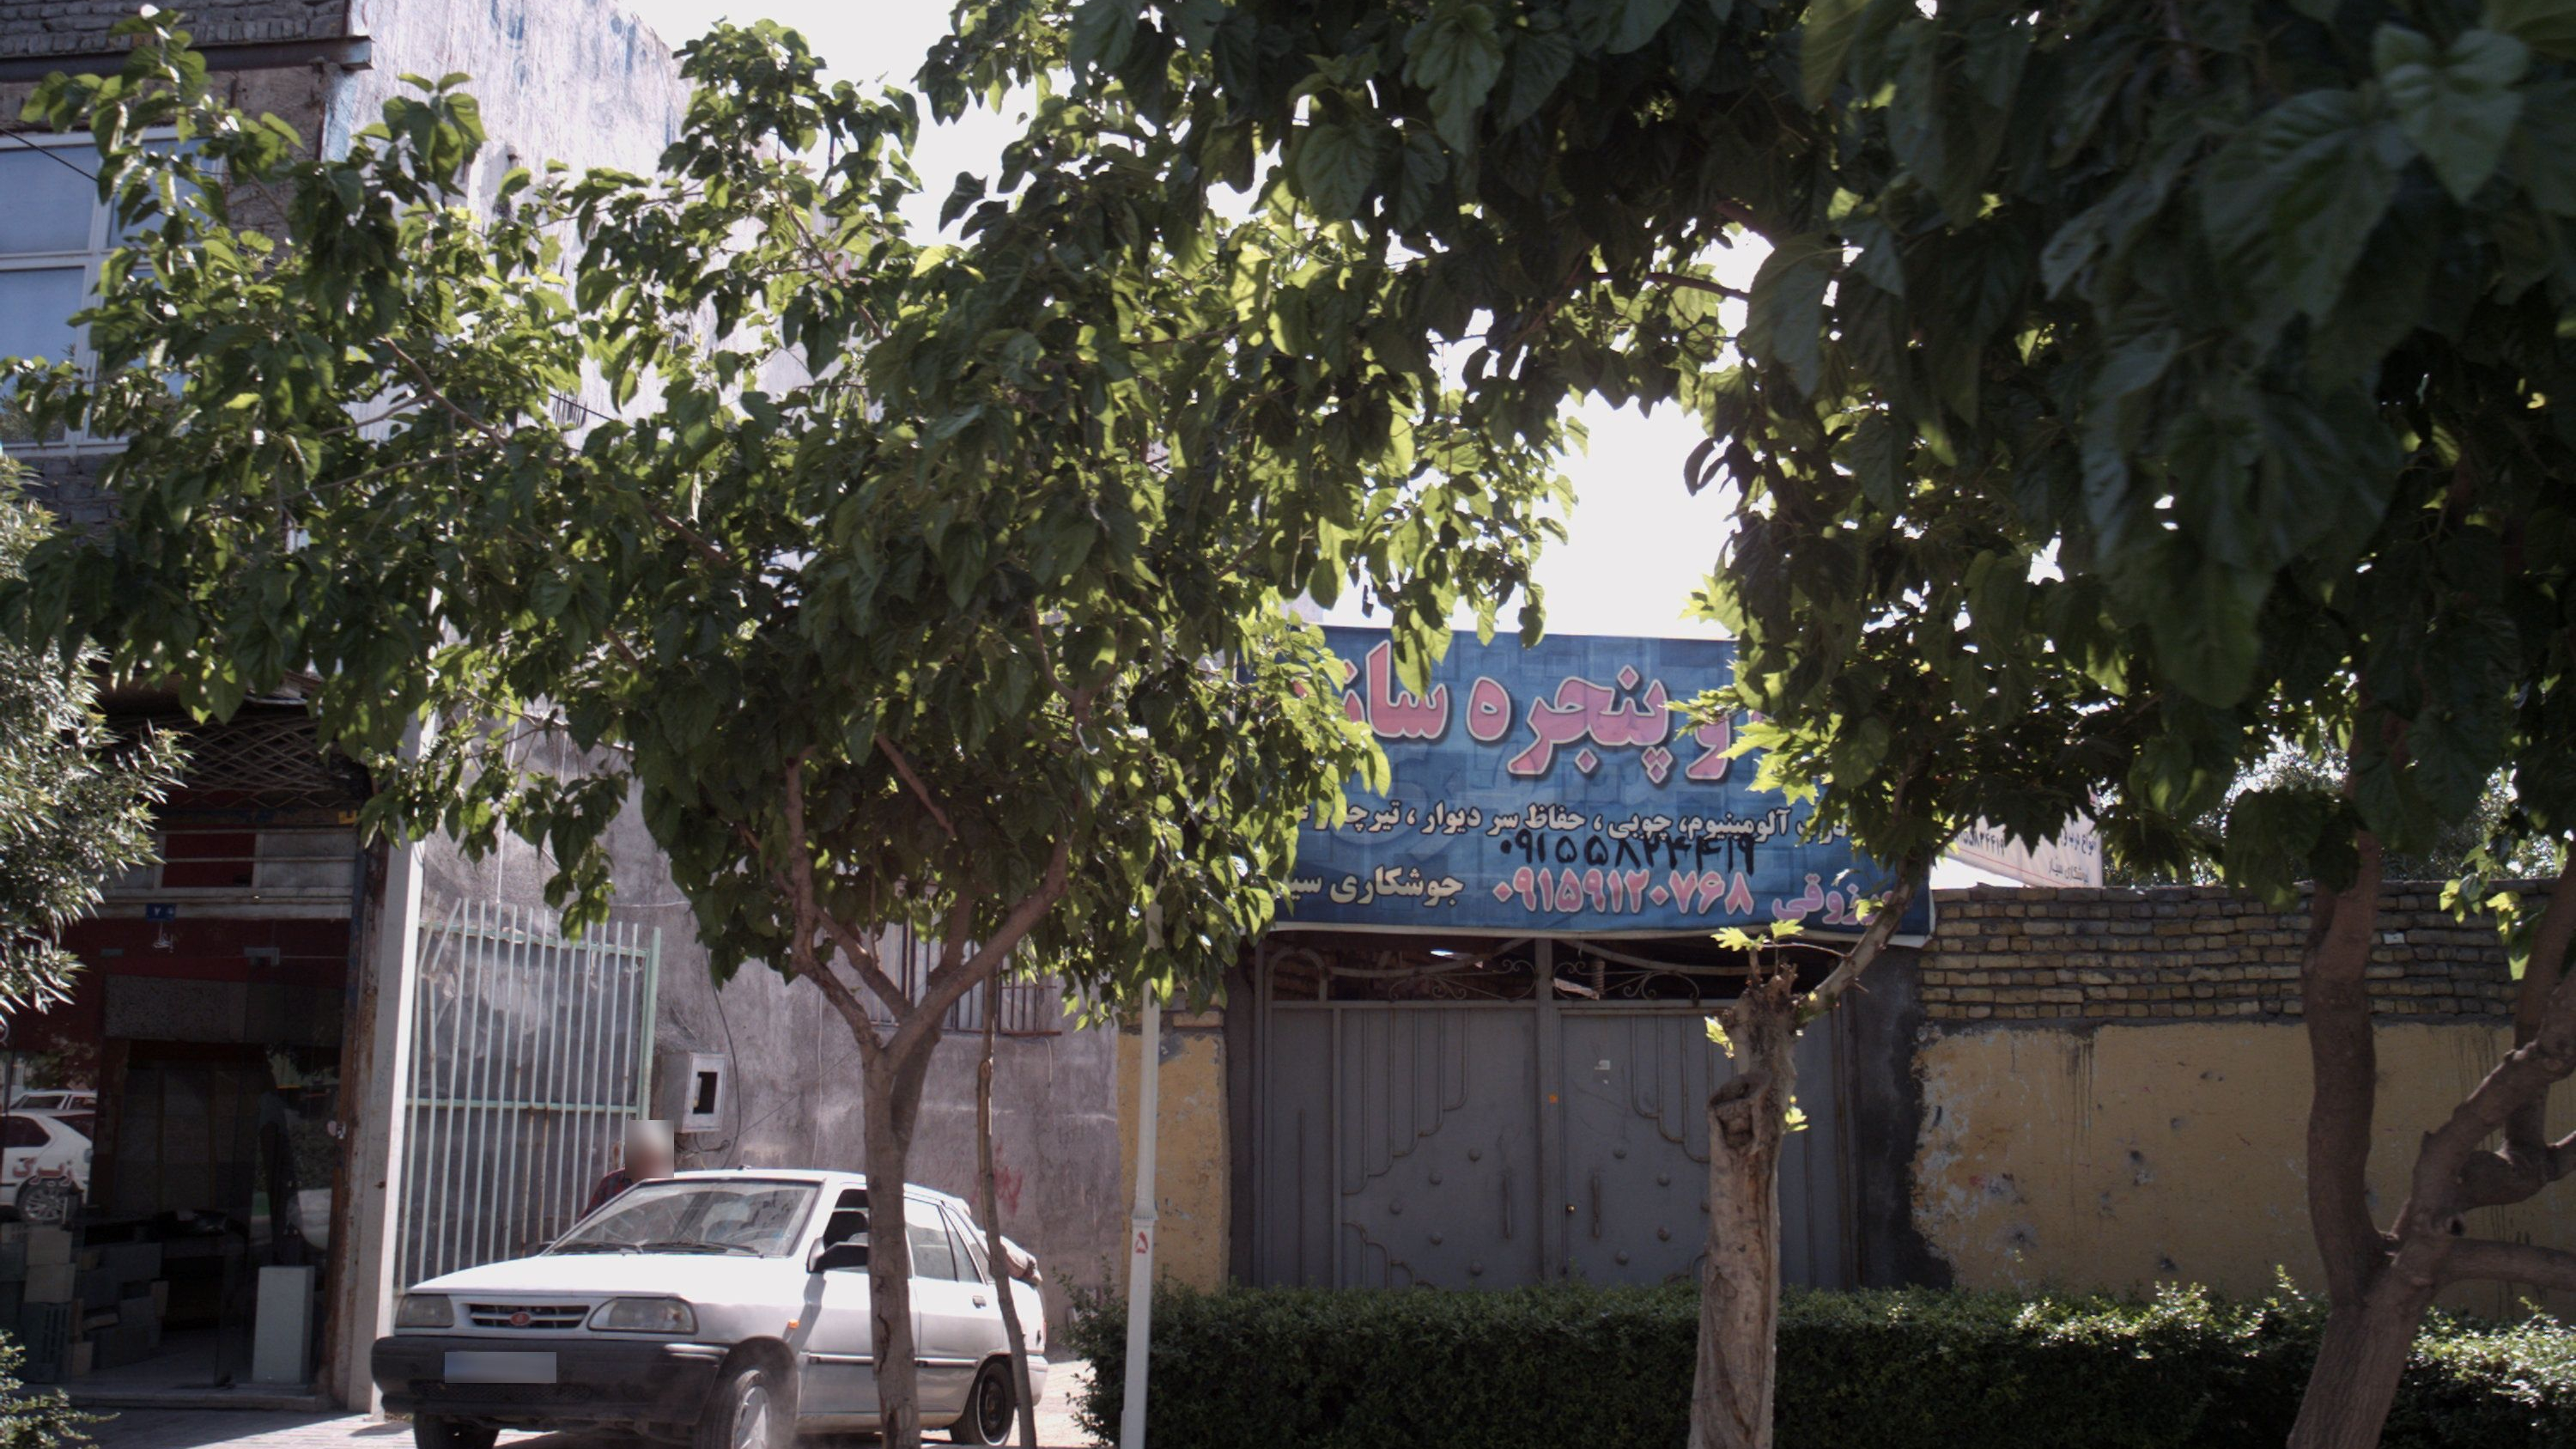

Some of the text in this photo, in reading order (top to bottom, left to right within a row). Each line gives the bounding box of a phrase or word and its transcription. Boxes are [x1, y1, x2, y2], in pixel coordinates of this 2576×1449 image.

[1466, 664, 1670, 783] پنجره
[1344, 801, 1402, 832] تیرچ
[1421, 801, 1482, 834] دیوار
[1486, 813, 1519, 835] سر
[1524, 803, 1586, 830] حفاظ
[1330, 864, 1464, 907] جوشکاری
[1492, 866, 1755, 916] ۰۹۱۵۹۱۲۰۷۶۸
